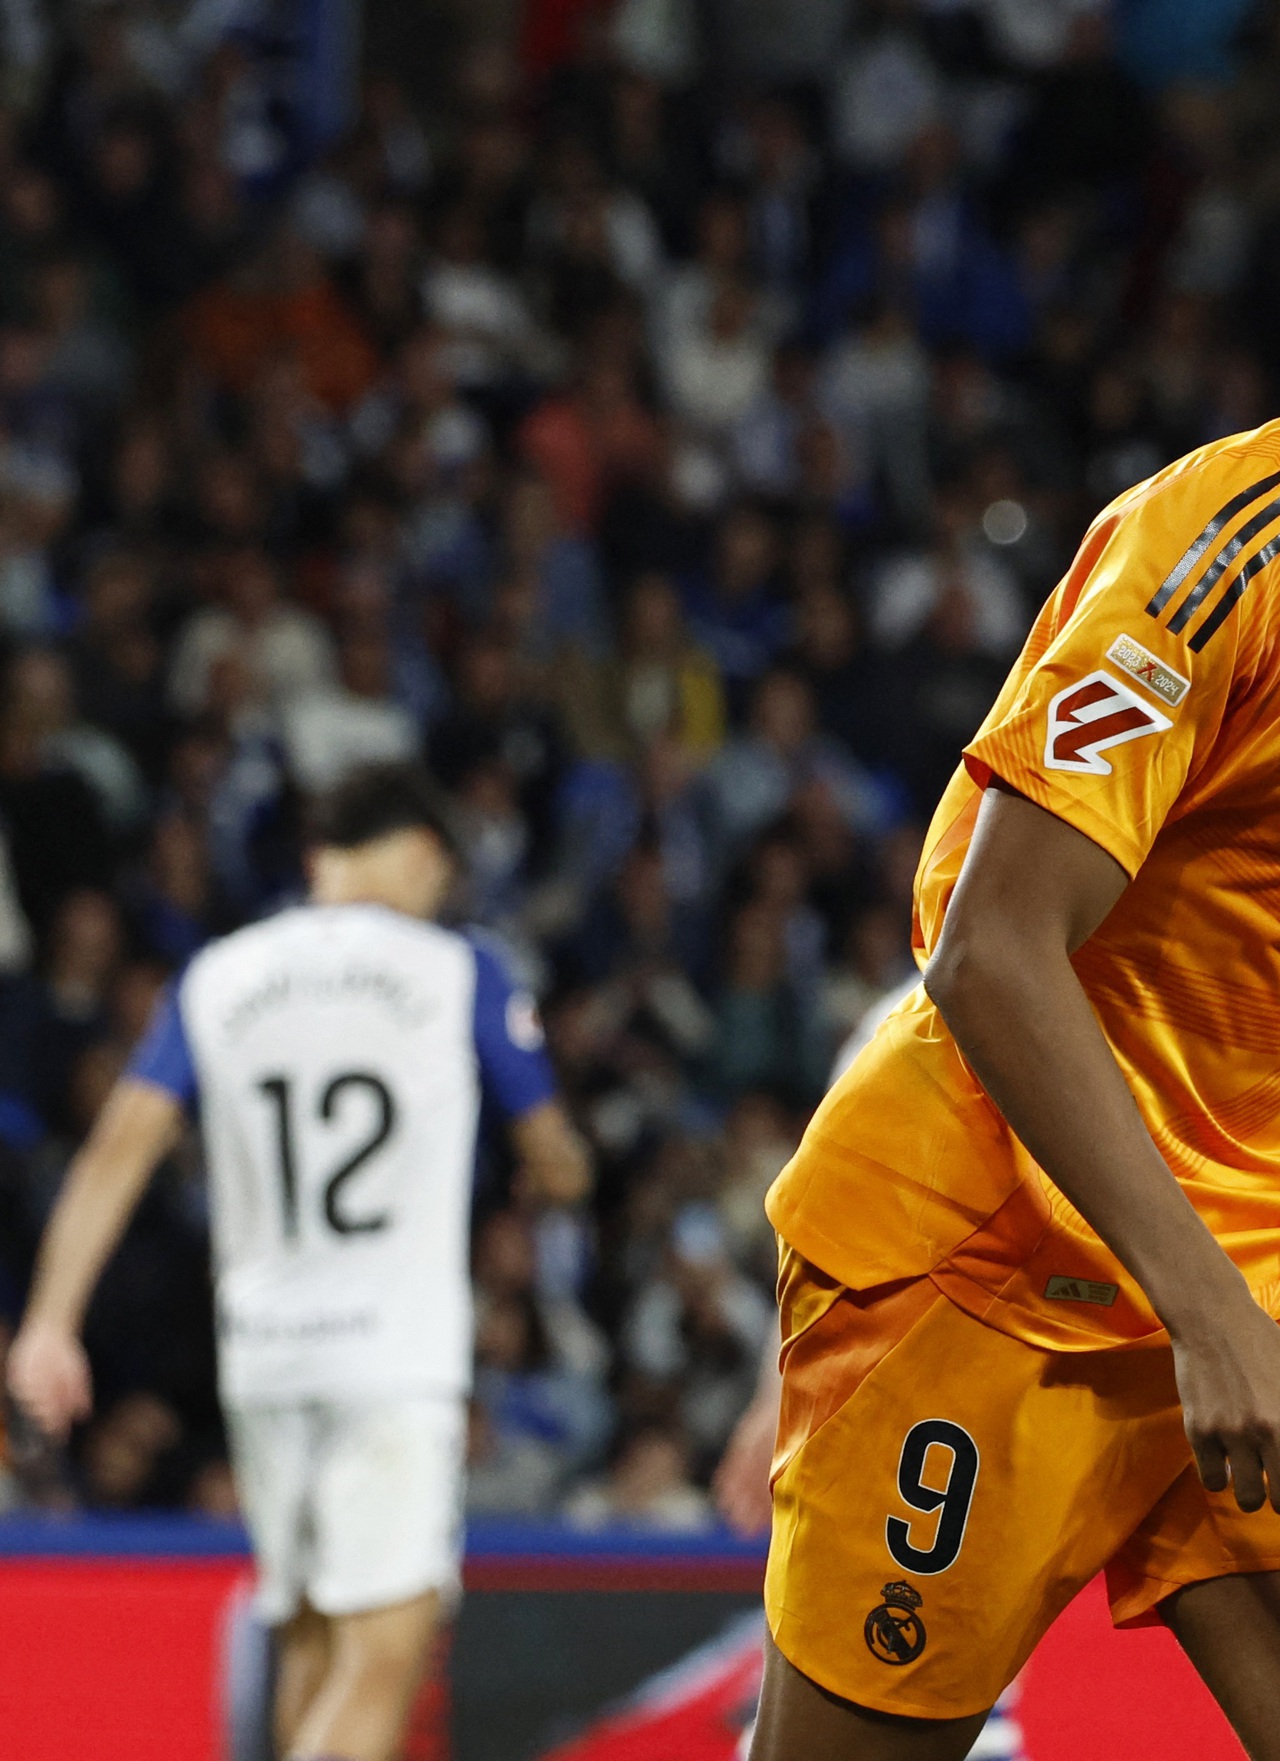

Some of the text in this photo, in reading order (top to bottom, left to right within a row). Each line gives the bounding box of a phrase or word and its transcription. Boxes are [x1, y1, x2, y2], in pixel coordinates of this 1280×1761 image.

[1154, 674, 1180, 696] 2024
[257, 1070, 399, 1240] 12
[885, 1419, 980, 1576] 9
